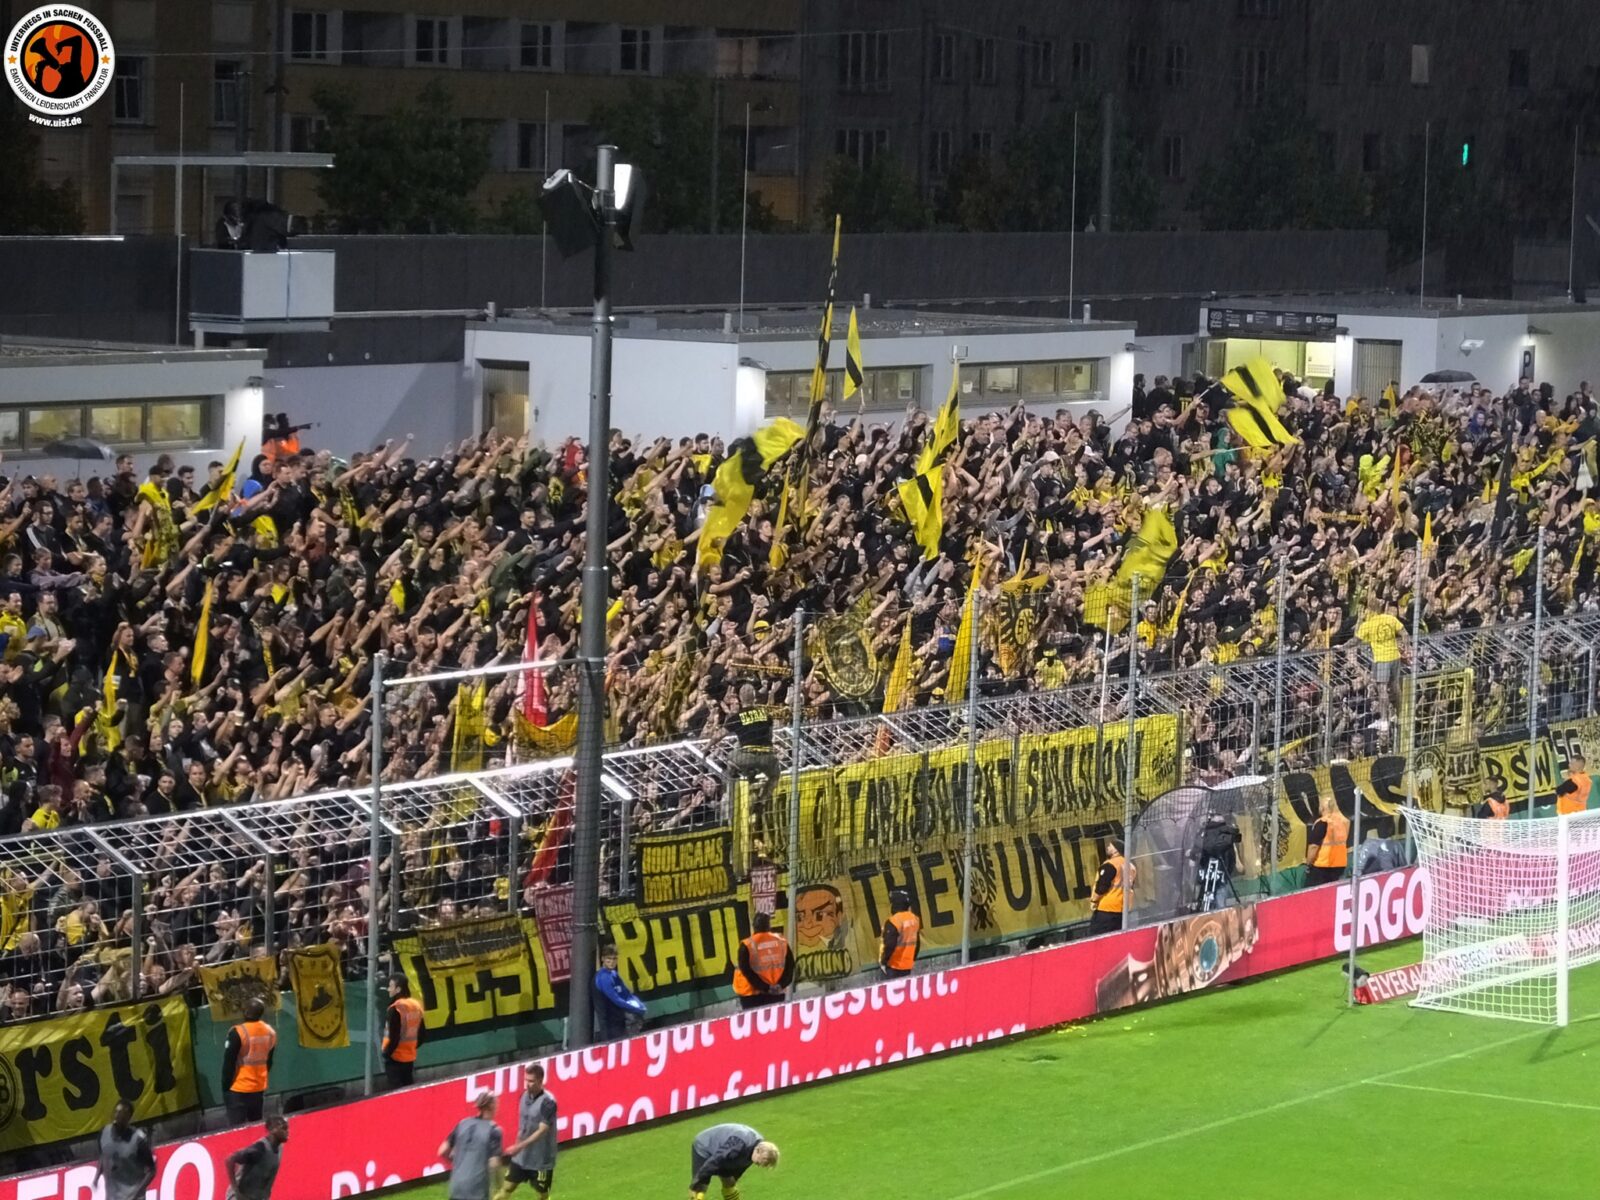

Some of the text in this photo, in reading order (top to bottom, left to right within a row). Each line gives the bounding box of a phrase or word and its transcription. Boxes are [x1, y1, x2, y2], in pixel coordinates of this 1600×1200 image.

[1484, 740, 1550, 793] BSW
[642, 837, 724, 874] HOOLIGANS
[642, 865, 730, 902] DORTMUND
[849, 851, 955, 938] THE
[1334, 866, 1432, 952] ERGO
[15, 1003, 177, 1122] rsti
